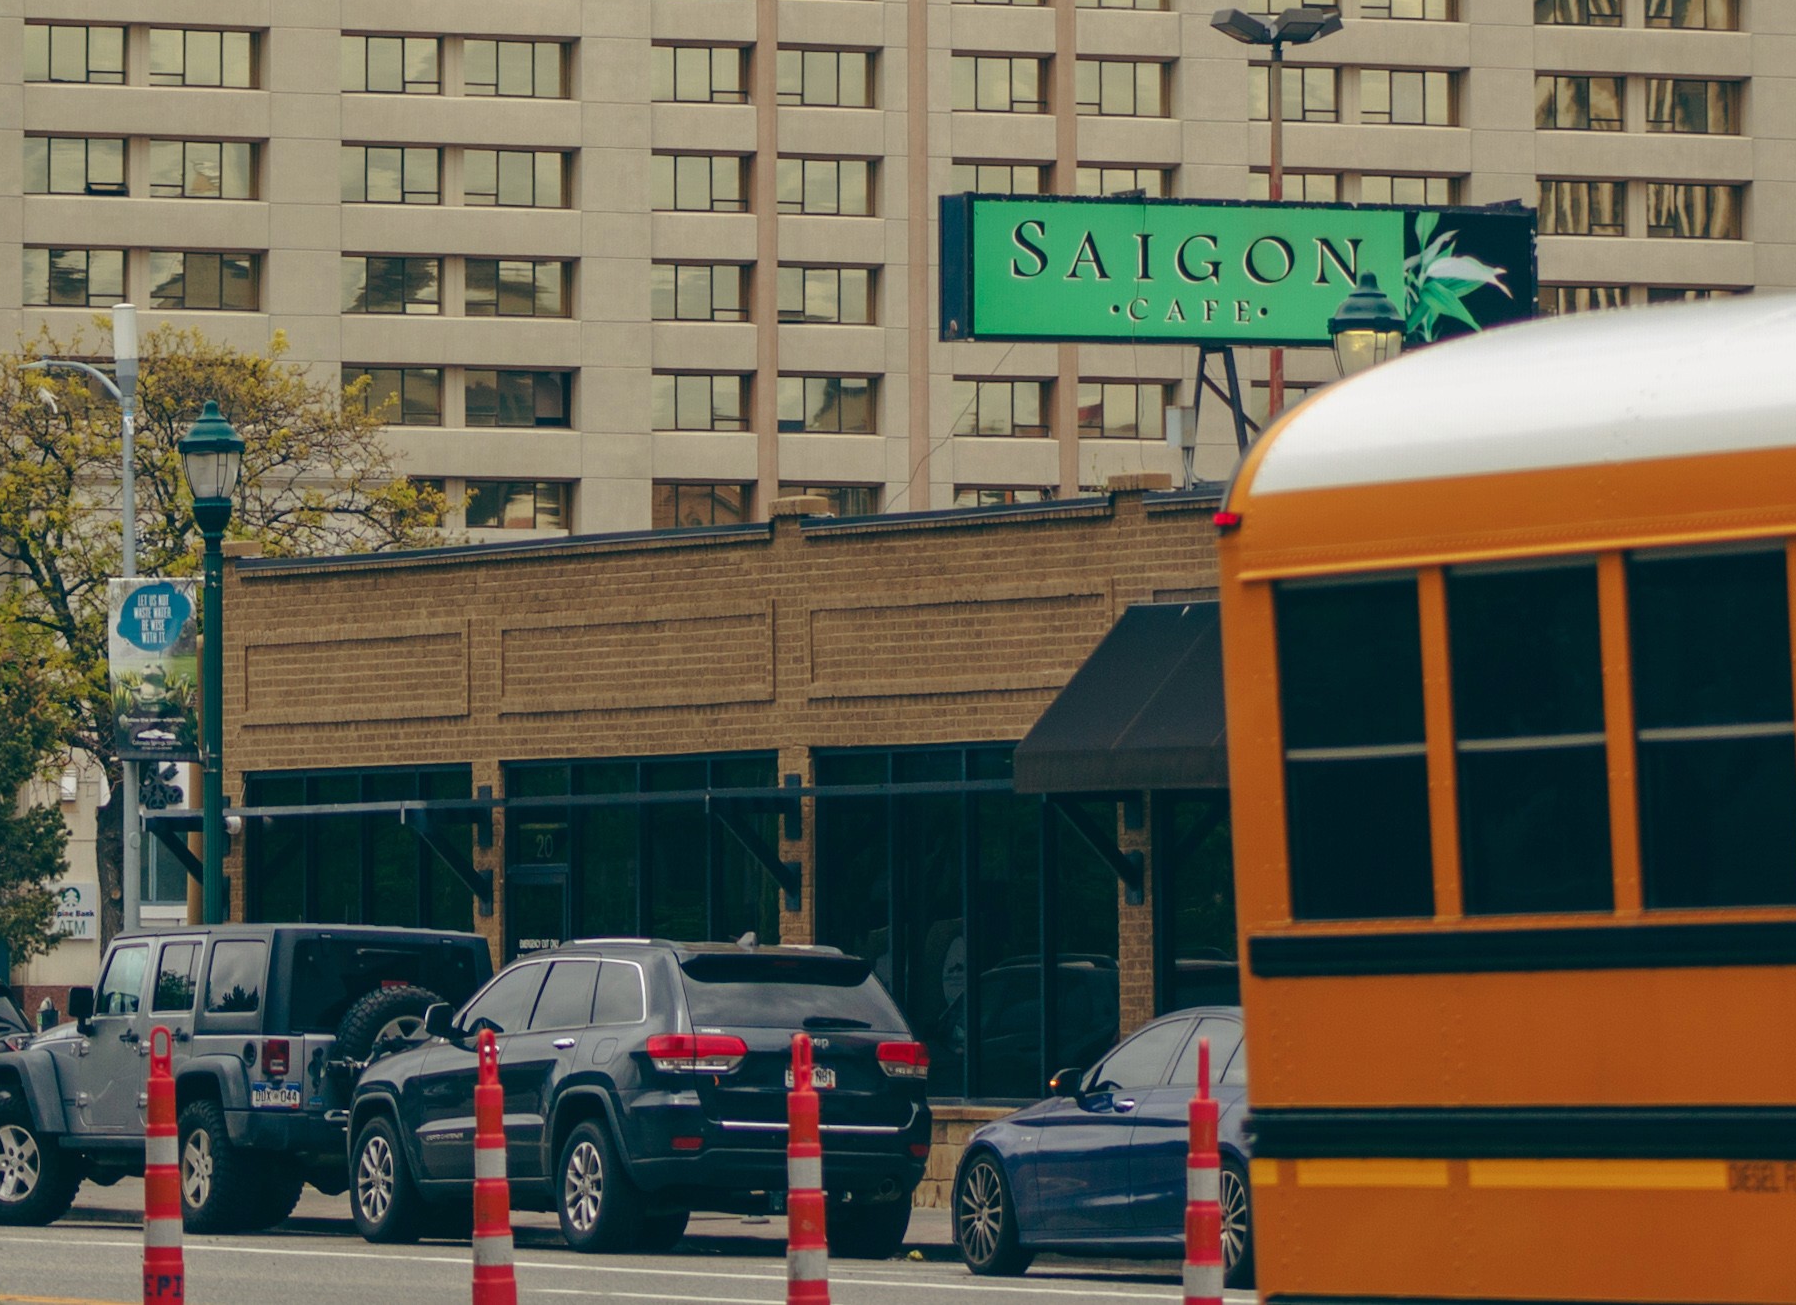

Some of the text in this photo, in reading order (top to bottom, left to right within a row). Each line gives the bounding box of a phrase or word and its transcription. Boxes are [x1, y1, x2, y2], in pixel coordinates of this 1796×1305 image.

[1010, 219, 1363, 286] SAIGON
[137, 594, 169, 606] LET US NOT
[134, 606, 152, 619] WASTE
[141, 619, 165, 631] BE WISE
[141, 631, 157, 644] WITH
[535, 834, 553, 858] 20
[58, 920, 86, 935] ATM
[1728, 1162, 1780, 1193] DIESEL
